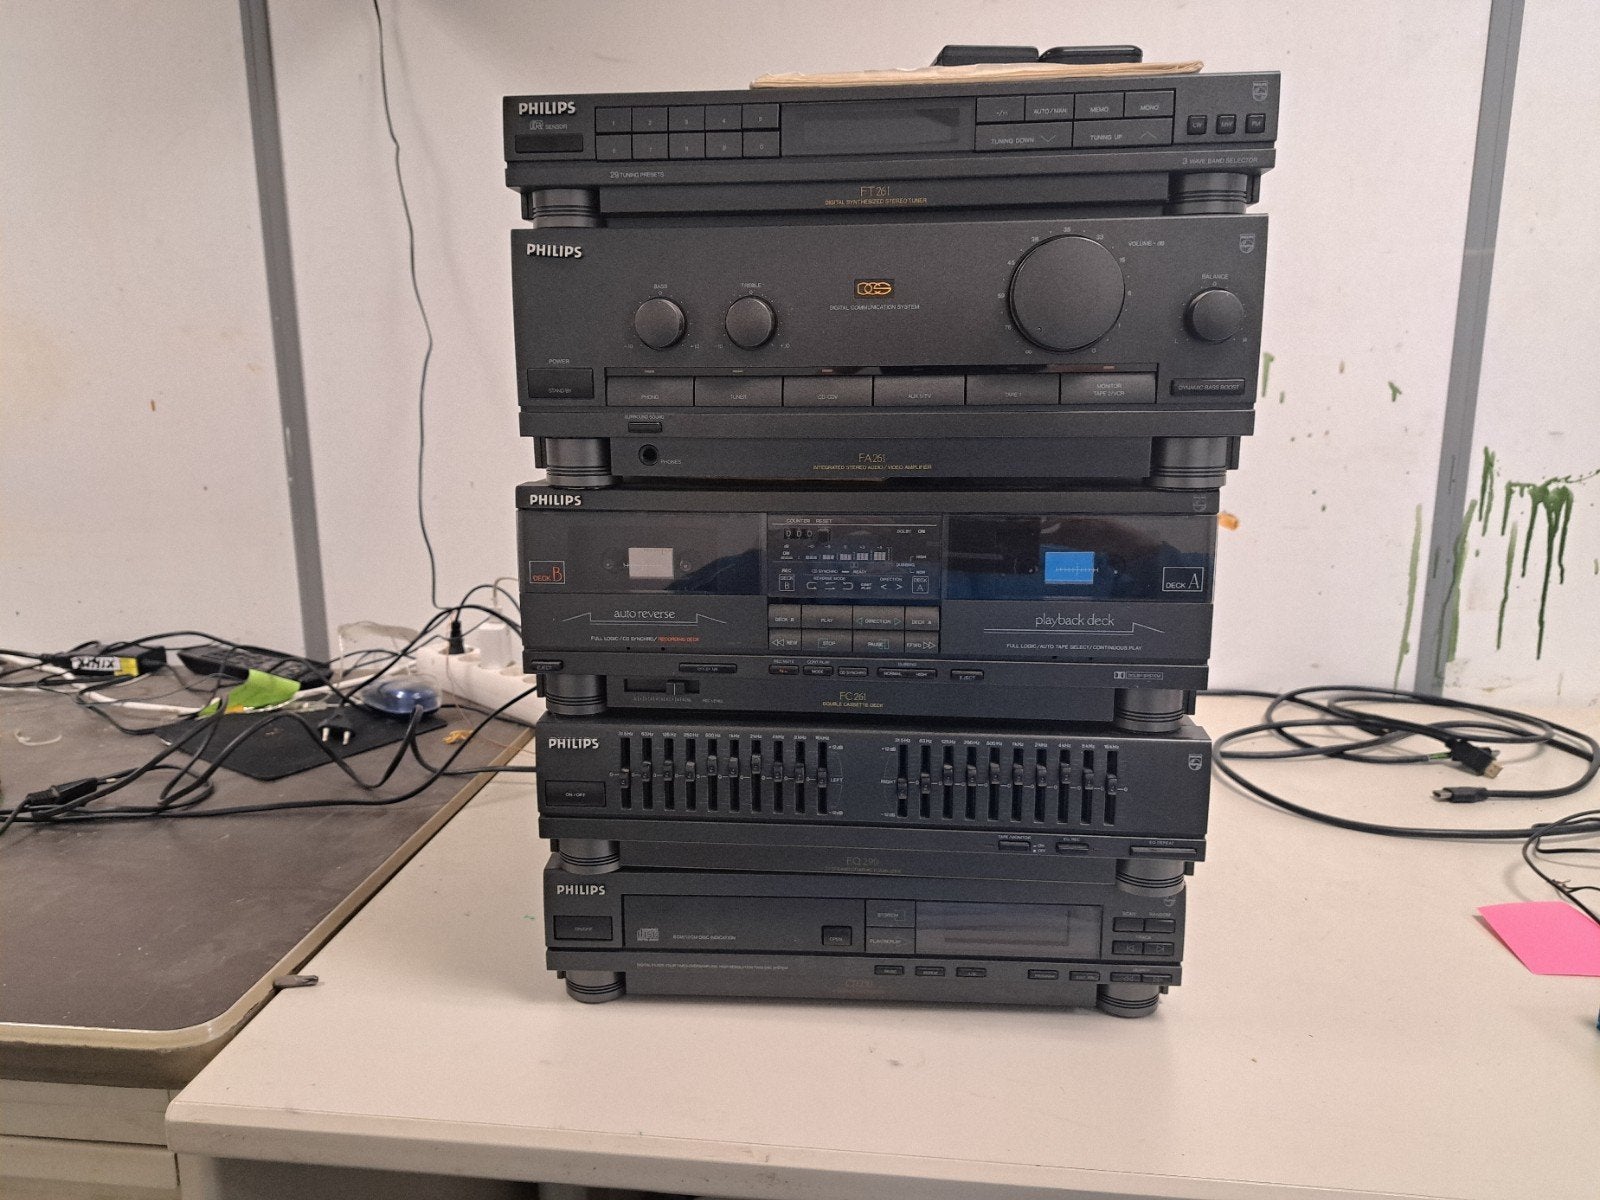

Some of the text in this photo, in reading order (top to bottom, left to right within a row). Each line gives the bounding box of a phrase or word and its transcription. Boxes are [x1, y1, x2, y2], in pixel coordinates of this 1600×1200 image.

[518, 102, 576, 115] PHILIPS
[860, 186, 890, 196] FT 261
[527, 244, 583, 258] PHILIPS
[530, 494, 581, 506] PHILIPS
[552, 566, 562, 581] B
[1188, 573, 1200, 589] A
[614, 609, 675, 618] auto reverse
[1036, 613, 1115, 626] playback deck
[854, 692, 866, 700] 261
[548, 738, 599, 749] PHILIPS
[556, 884, 605, 895] PHILIPS
